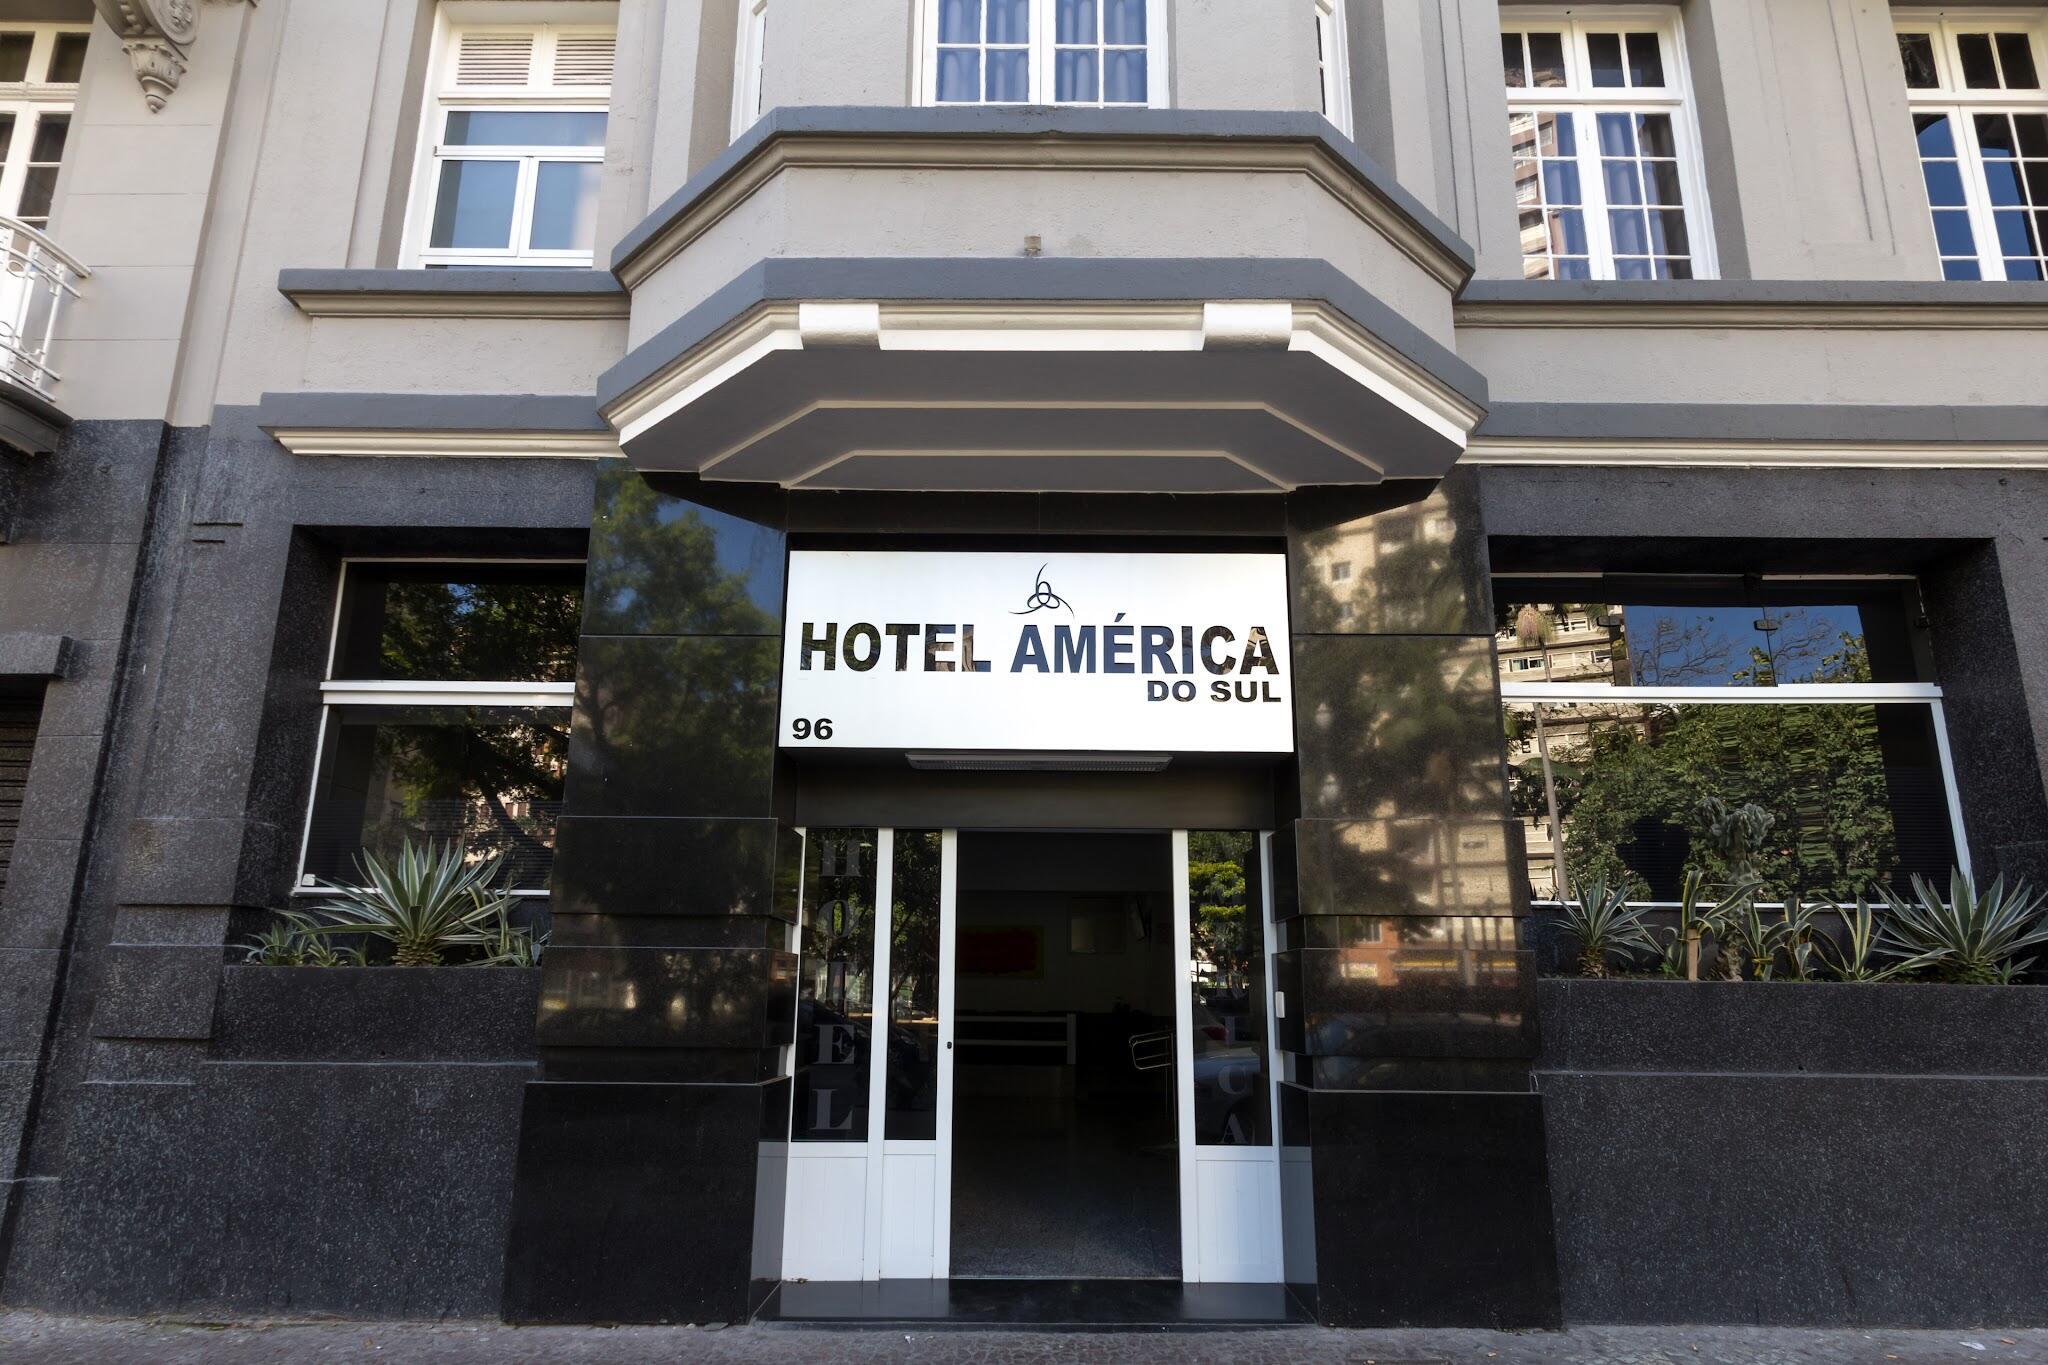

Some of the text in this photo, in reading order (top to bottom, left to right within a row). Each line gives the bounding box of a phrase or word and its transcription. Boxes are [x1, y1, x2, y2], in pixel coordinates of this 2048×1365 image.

[800, 612, 1280, 676] HOTEL AMÉRICA
[1147, 680, 1281, 703] DO SUL
[792, 717, 834, 741] 96
